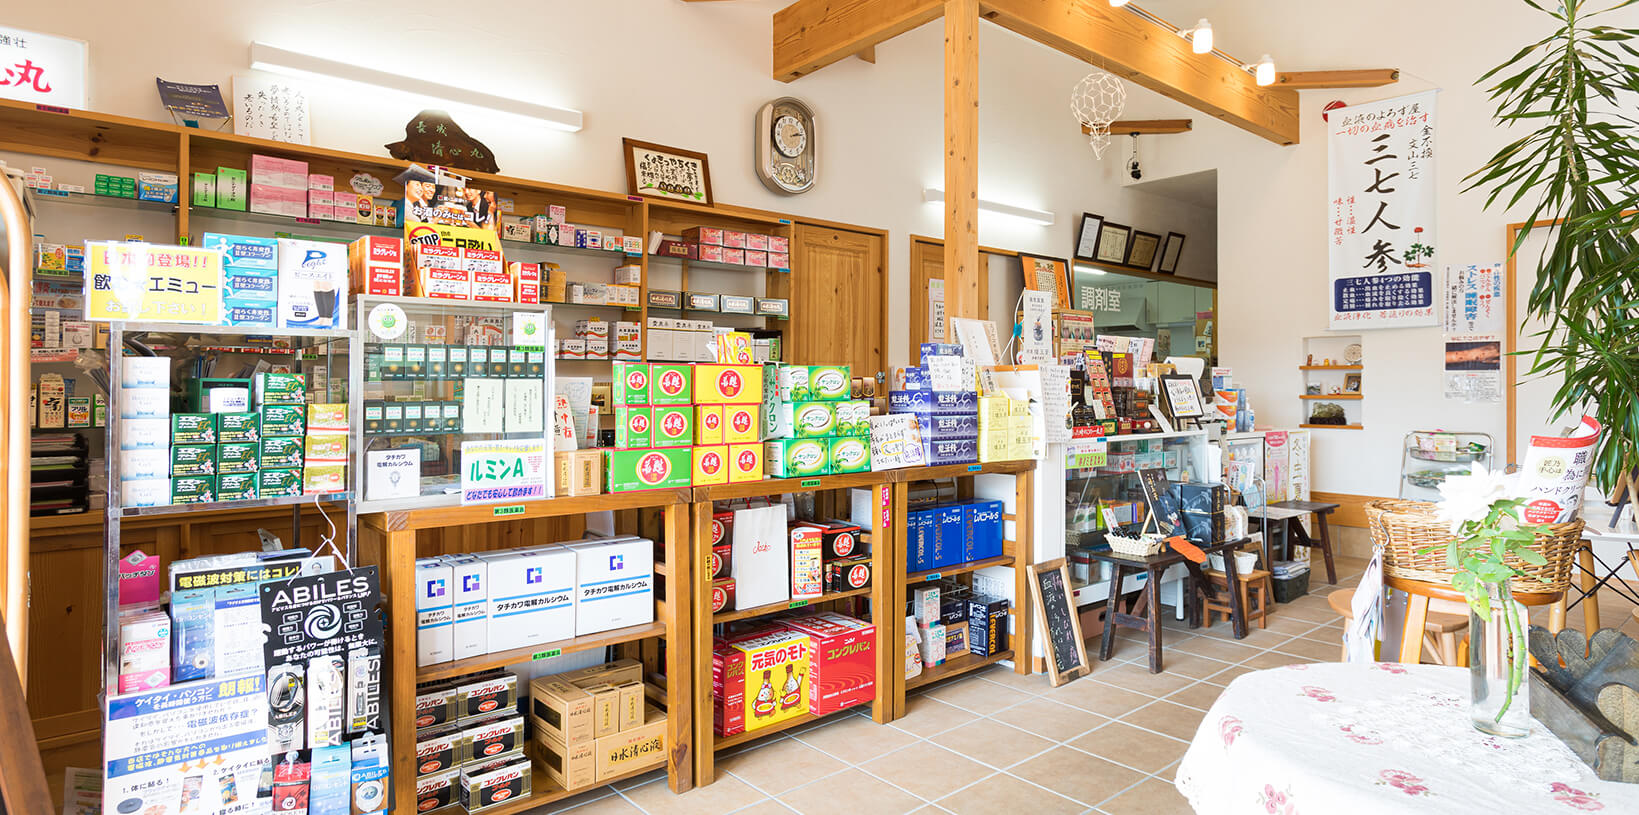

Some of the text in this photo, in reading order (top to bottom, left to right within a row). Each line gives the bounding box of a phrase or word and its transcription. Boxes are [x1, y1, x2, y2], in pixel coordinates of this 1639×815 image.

[1361, 133, 1402, 274] 三七人参
[1081, 286, 1121, 312] 調剤室
[470, 457, 524, 482] ルミンA
[178, 566, 300, 589] 電磁波対策にはコレ!
[583, 580, 648, 597] タチカワ電解カルシウム
[271, 576, 370, 607] ABILES
[496, 594, 569, 612] タチカワ電解カルシウム
[751, 643, 808, 671] 元気のモト
[218, 677, 261, 698] 朗報!
[366, 659, 382, 729] ABILES
